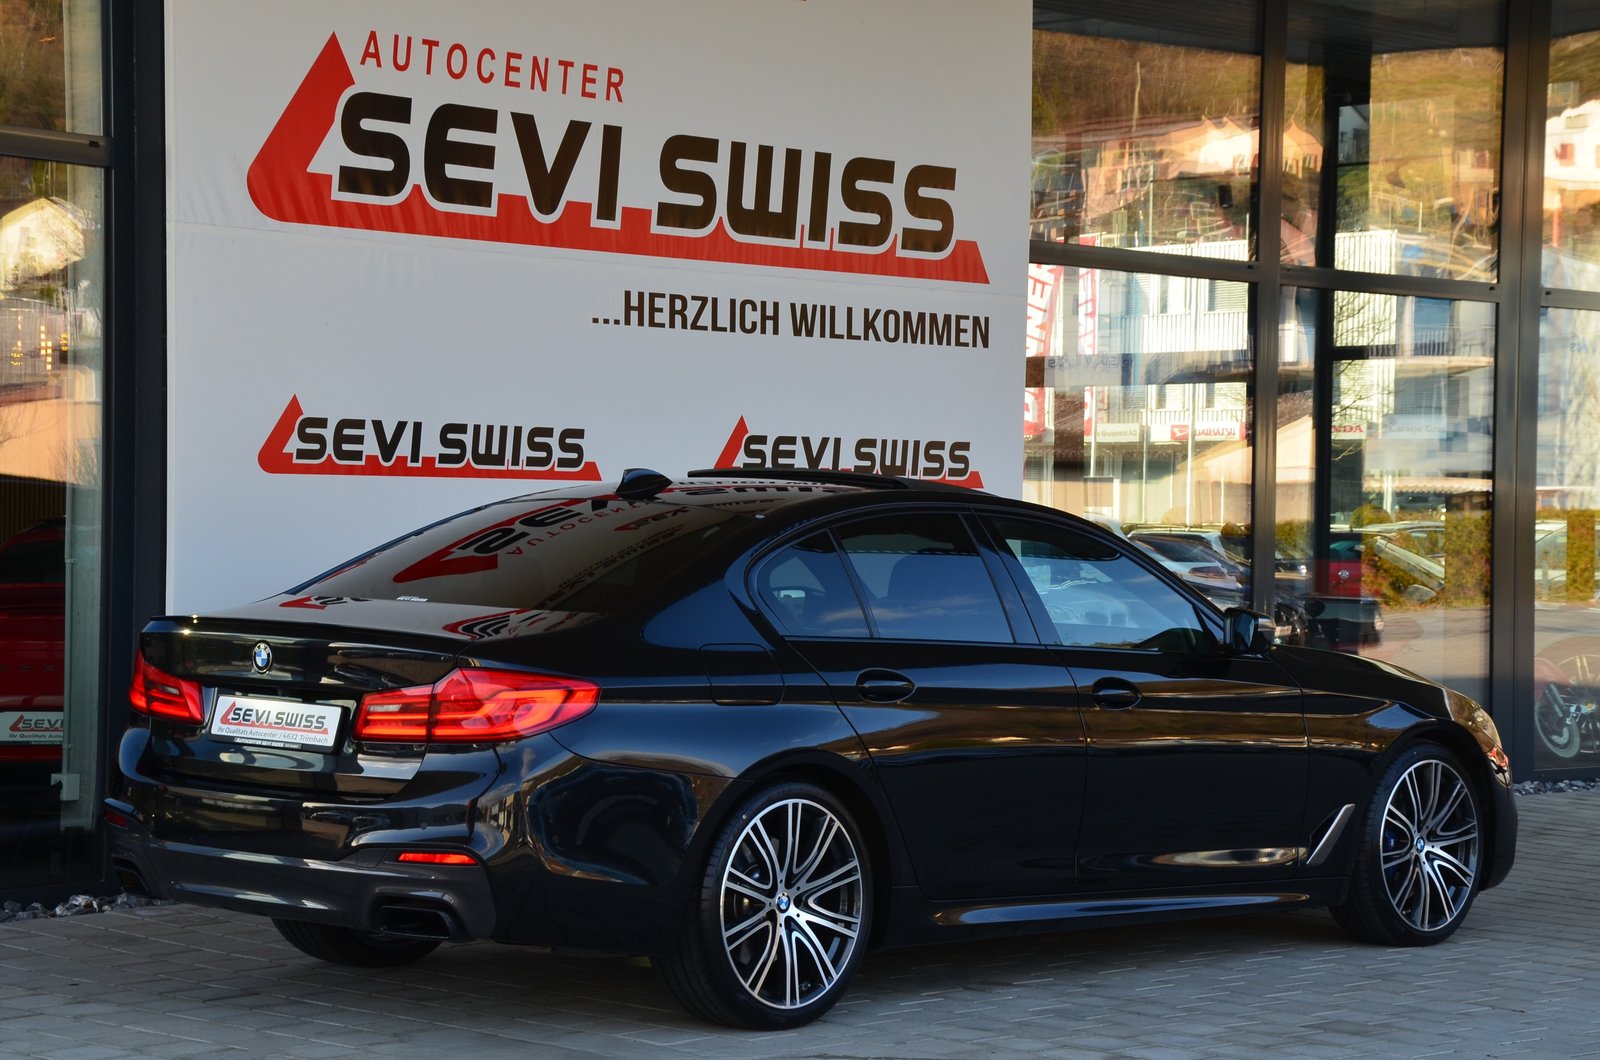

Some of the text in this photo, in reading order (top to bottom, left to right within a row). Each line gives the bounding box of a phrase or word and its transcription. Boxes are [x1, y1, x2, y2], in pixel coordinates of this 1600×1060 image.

[359, 29, 625, 104] AUTOCENTER
[337, 91, 957, 254] SEVI SWISS
[591, 290, 991, 349] ...HERZLICH WILLKOMMEN
[295, 416, 586, 469] SEVI SWISS
[743, 434, 971, 479] SEVI SWISS
[231, 707, 327, 730] SEVI SWISS
[249, 730, 278, 739] Autocenter
[282, 732, 298, 741] 4632
[299, 735, 329, 744] Trimbach
